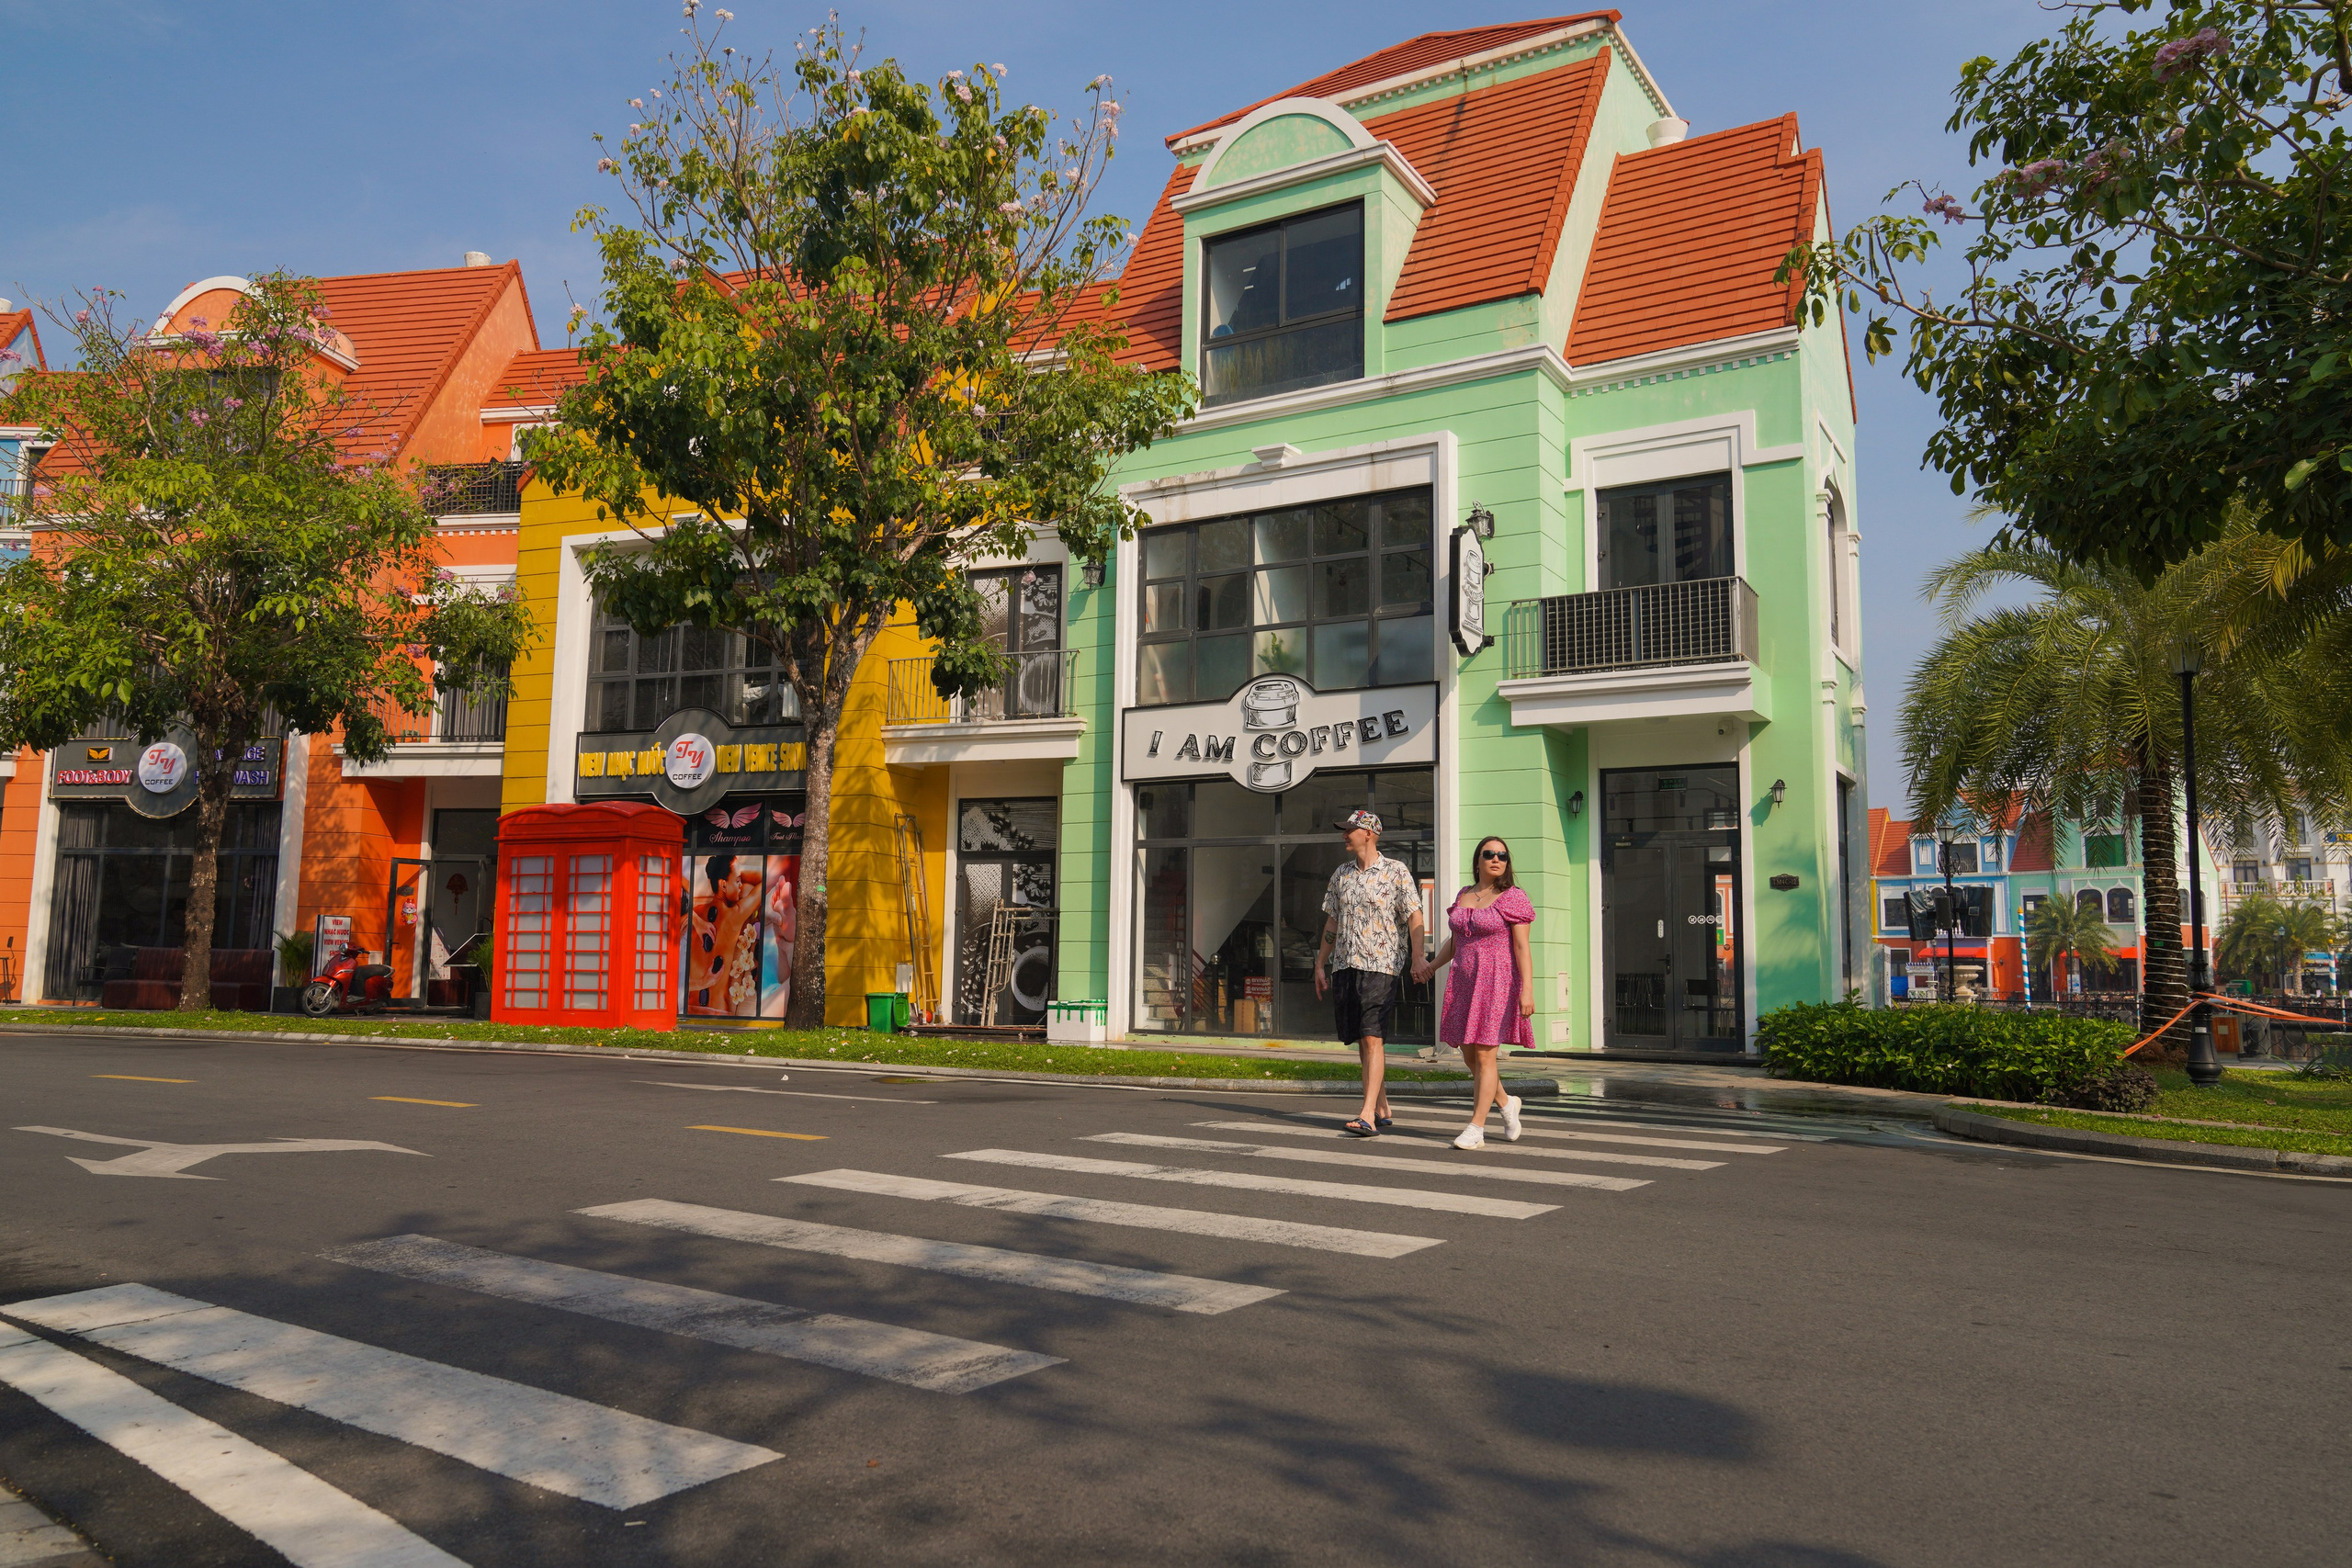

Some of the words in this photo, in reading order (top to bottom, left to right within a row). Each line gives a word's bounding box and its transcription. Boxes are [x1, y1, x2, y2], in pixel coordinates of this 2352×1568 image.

[1149, 730, 1164, 755] I
[1177, 733, 1237, 761] AM
[1252, 709, 1409, 759] COFFEE
[578, 751, 606, 777] VIEW
[606, 750, 636, 782] NHẠC
[716, 744, 742, 773] VIEW
[744, 742, 778, 773] VENICE
[57, 770, 132, 785] FOOT&BODY
[709, 830, 752, 846] Shampoo
